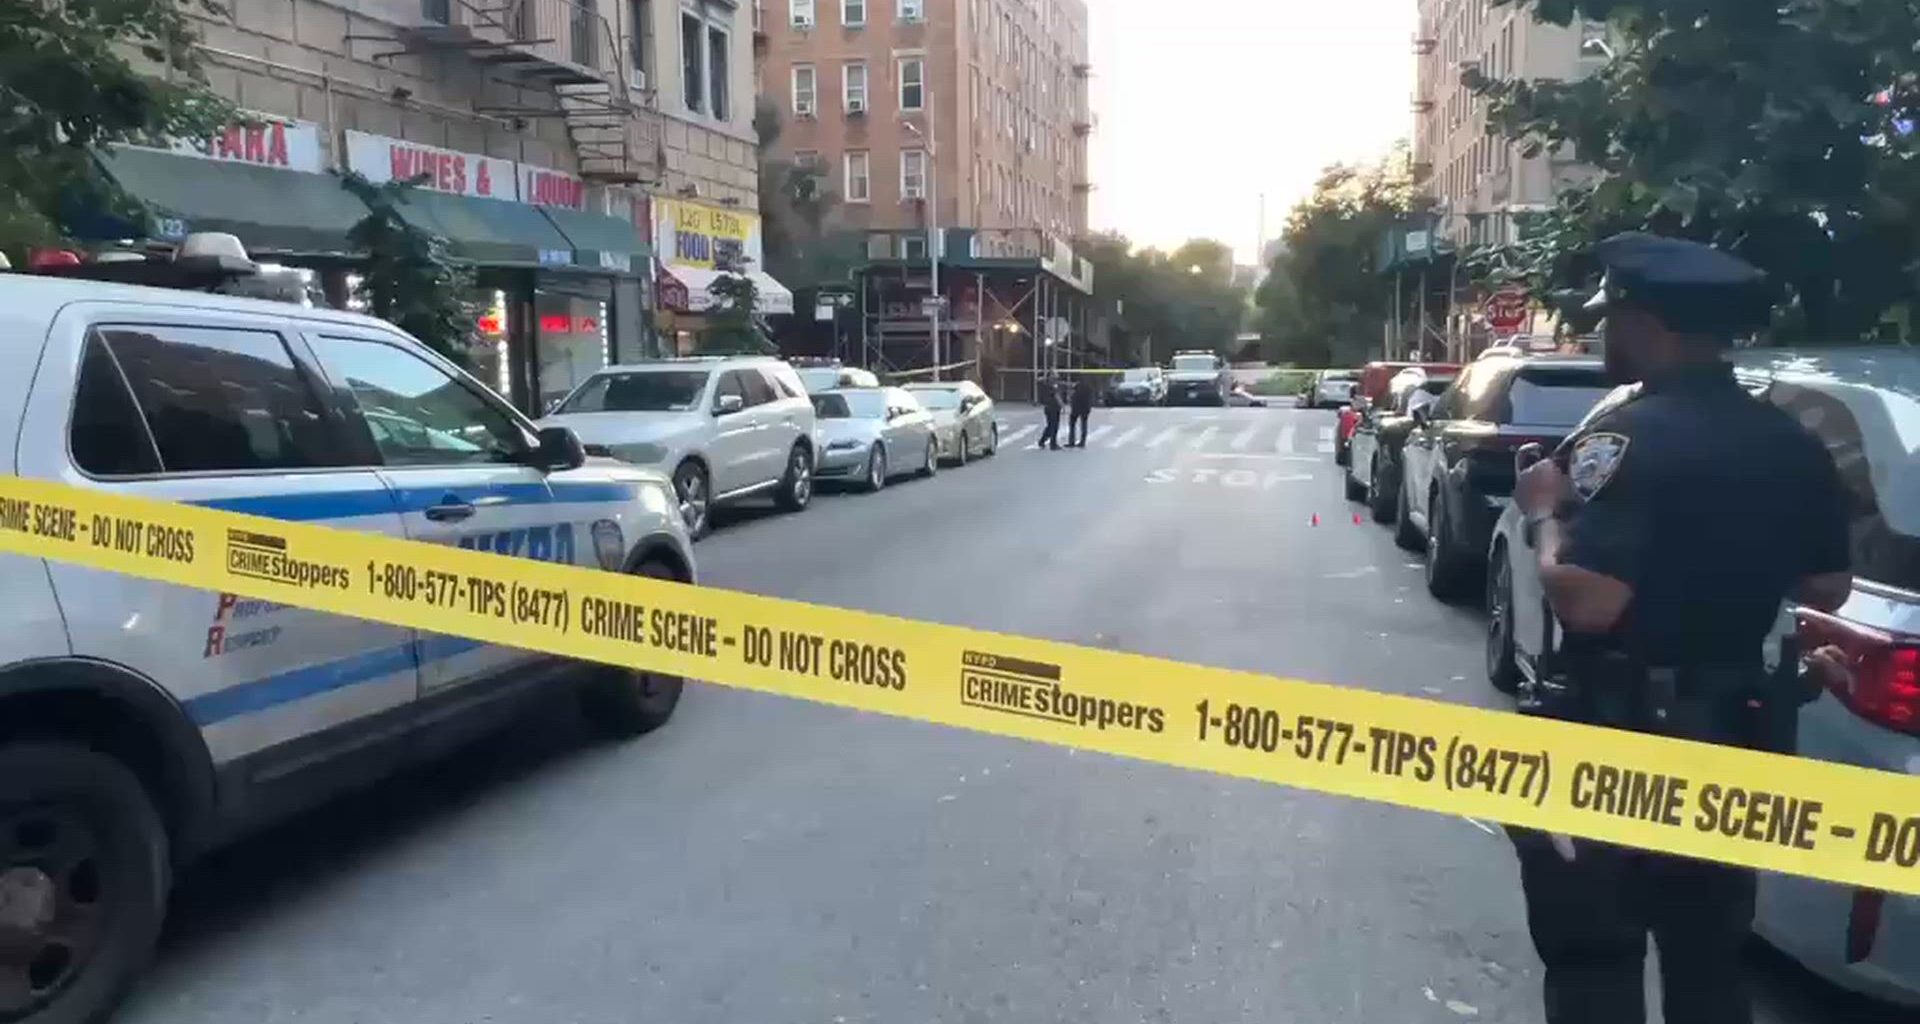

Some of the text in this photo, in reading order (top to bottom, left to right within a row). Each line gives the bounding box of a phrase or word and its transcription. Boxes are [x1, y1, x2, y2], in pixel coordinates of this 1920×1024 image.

[390, 144, 466, 191] WINES
[475, 160, 491, 196] &
[675, 230, 709, 261] FOOD
[33, 504, 76, 542] SCENE
[92, 514, 112, 548] DO
[115, 518, 144, 555] NOT
[146, 523, 195, 564] CROSS
[366, 560, 506, 618] 1-800-577-TIPS
[510, 580, 569, 634] (8477)
[581, 596, 645, 643] CRIME
[650, 608, 717, 657] SCENE
[743, 624, 772, 667] DO
[779, 631, 824, 677] NOT
[829, 639, 906, 691] CROSS
[1196, 697, 1550, 807] 1-800-577-TIPS (8477)
[1570, 761, 1688, 827] CRIME
[1694, 783, 1823, 850] SCENE
[1864, 812, 1920, 868] DO
